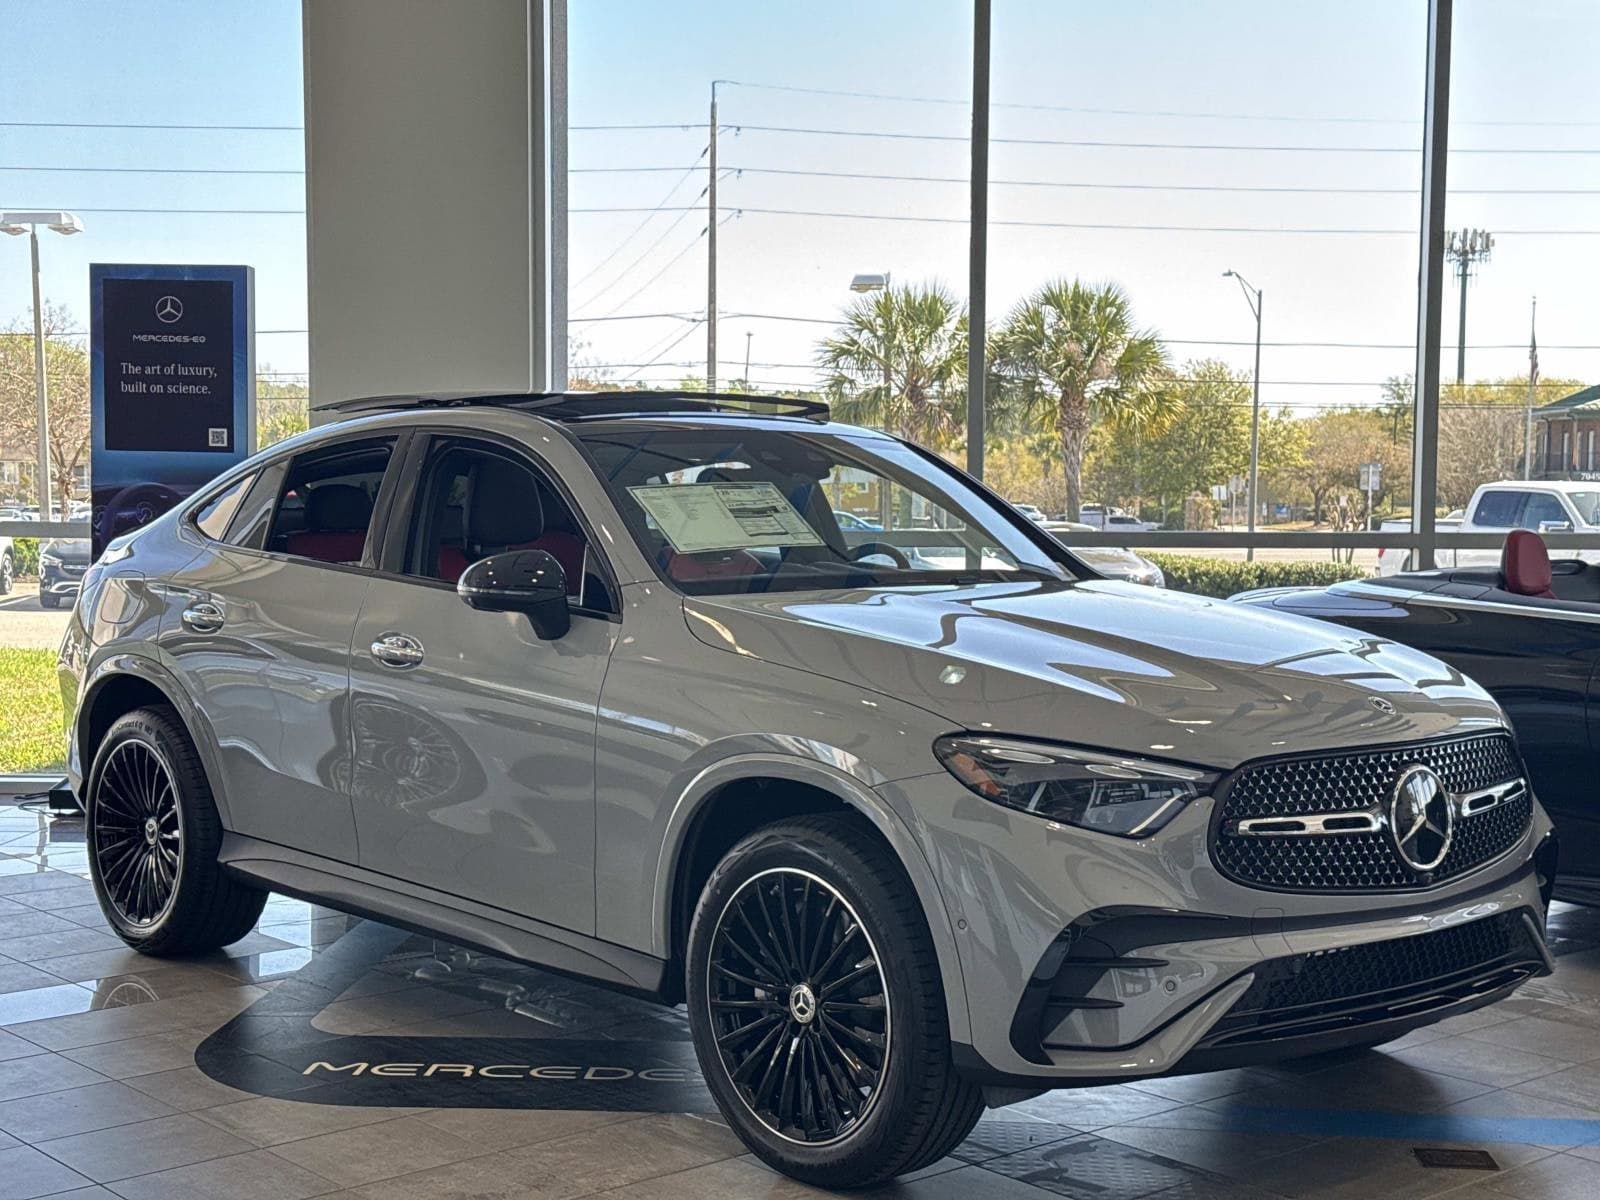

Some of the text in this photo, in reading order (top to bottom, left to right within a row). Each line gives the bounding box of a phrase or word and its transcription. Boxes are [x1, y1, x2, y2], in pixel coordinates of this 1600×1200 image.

[120, 362, 218, 379] The art of luxury,
[120, 381, 211, 395] built on science.
